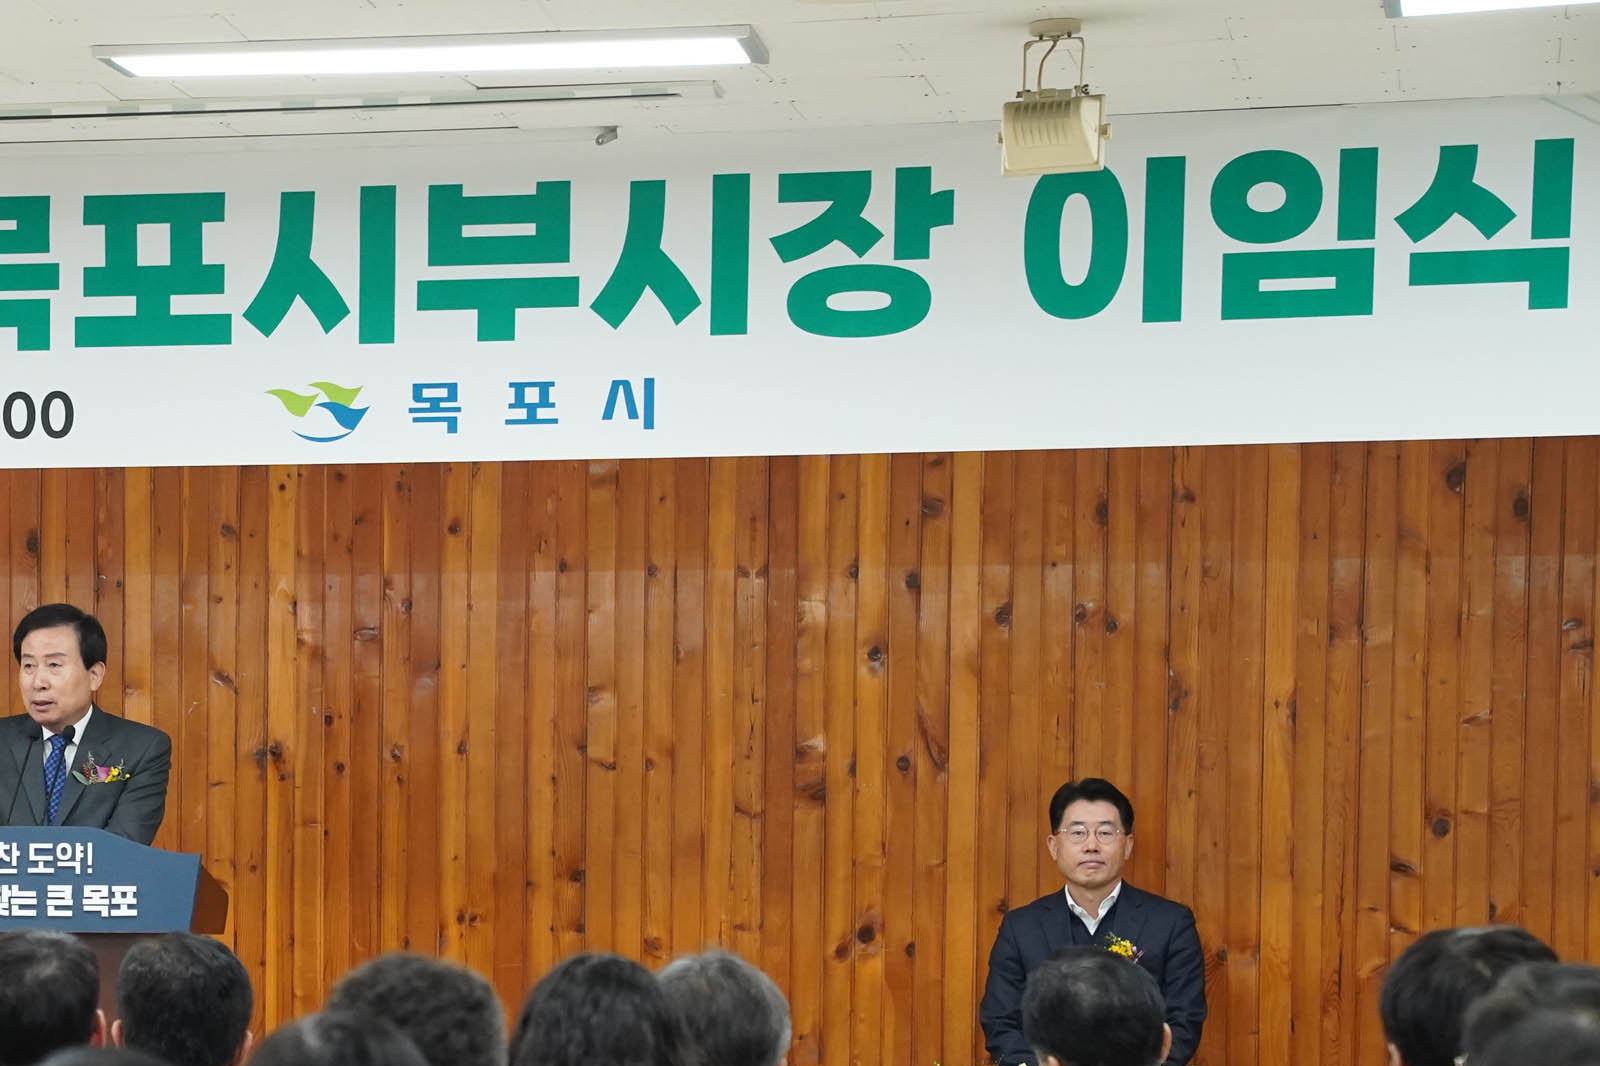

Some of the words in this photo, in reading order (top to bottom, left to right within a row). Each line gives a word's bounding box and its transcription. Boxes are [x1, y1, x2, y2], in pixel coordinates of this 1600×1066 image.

[1023, 137, 1575, 323] 이임식
[27, 841, 94, 875] 도약!
[46, 884, 74, 917] 큰
[82, 884, 138, 918] 목포
